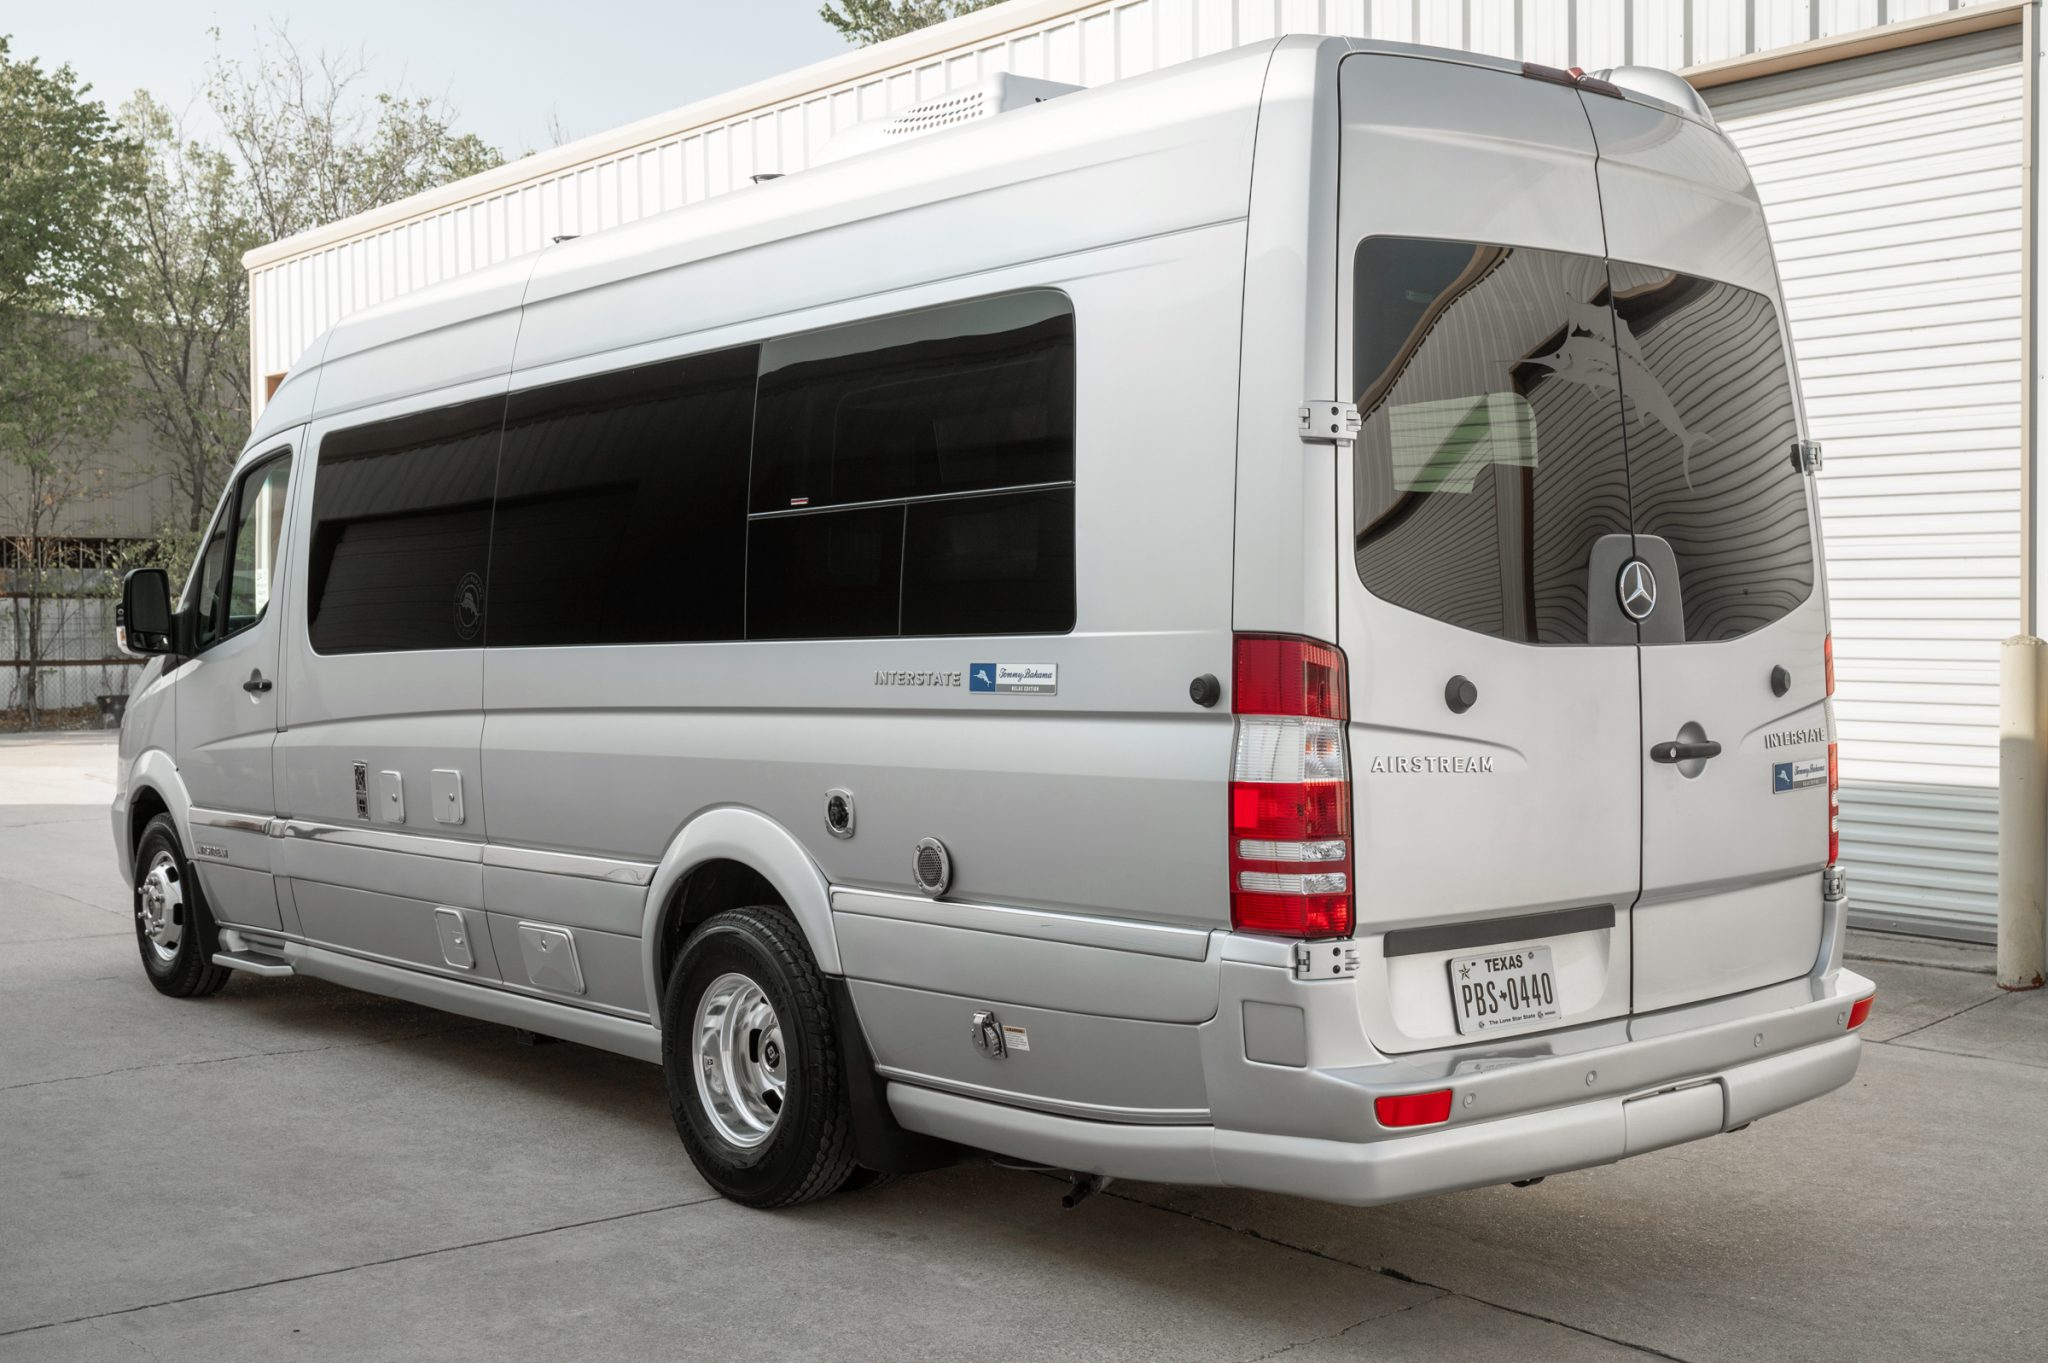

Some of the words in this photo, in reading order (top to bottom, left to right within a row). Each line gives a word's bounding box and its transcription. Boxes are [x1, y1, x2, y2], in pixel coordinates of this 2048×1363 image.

[873, 670, 962, 687] INTERSTATE
[998, 667, 1024, 682] Tommy
[1024, 667, 1053, 679] Bahama
[1764, 727, 1825, 749] INTERSTATE
[1370, 755, 1494, 773] AIRSTREAM
[1484, 954, 1523, 973] TEXAS
